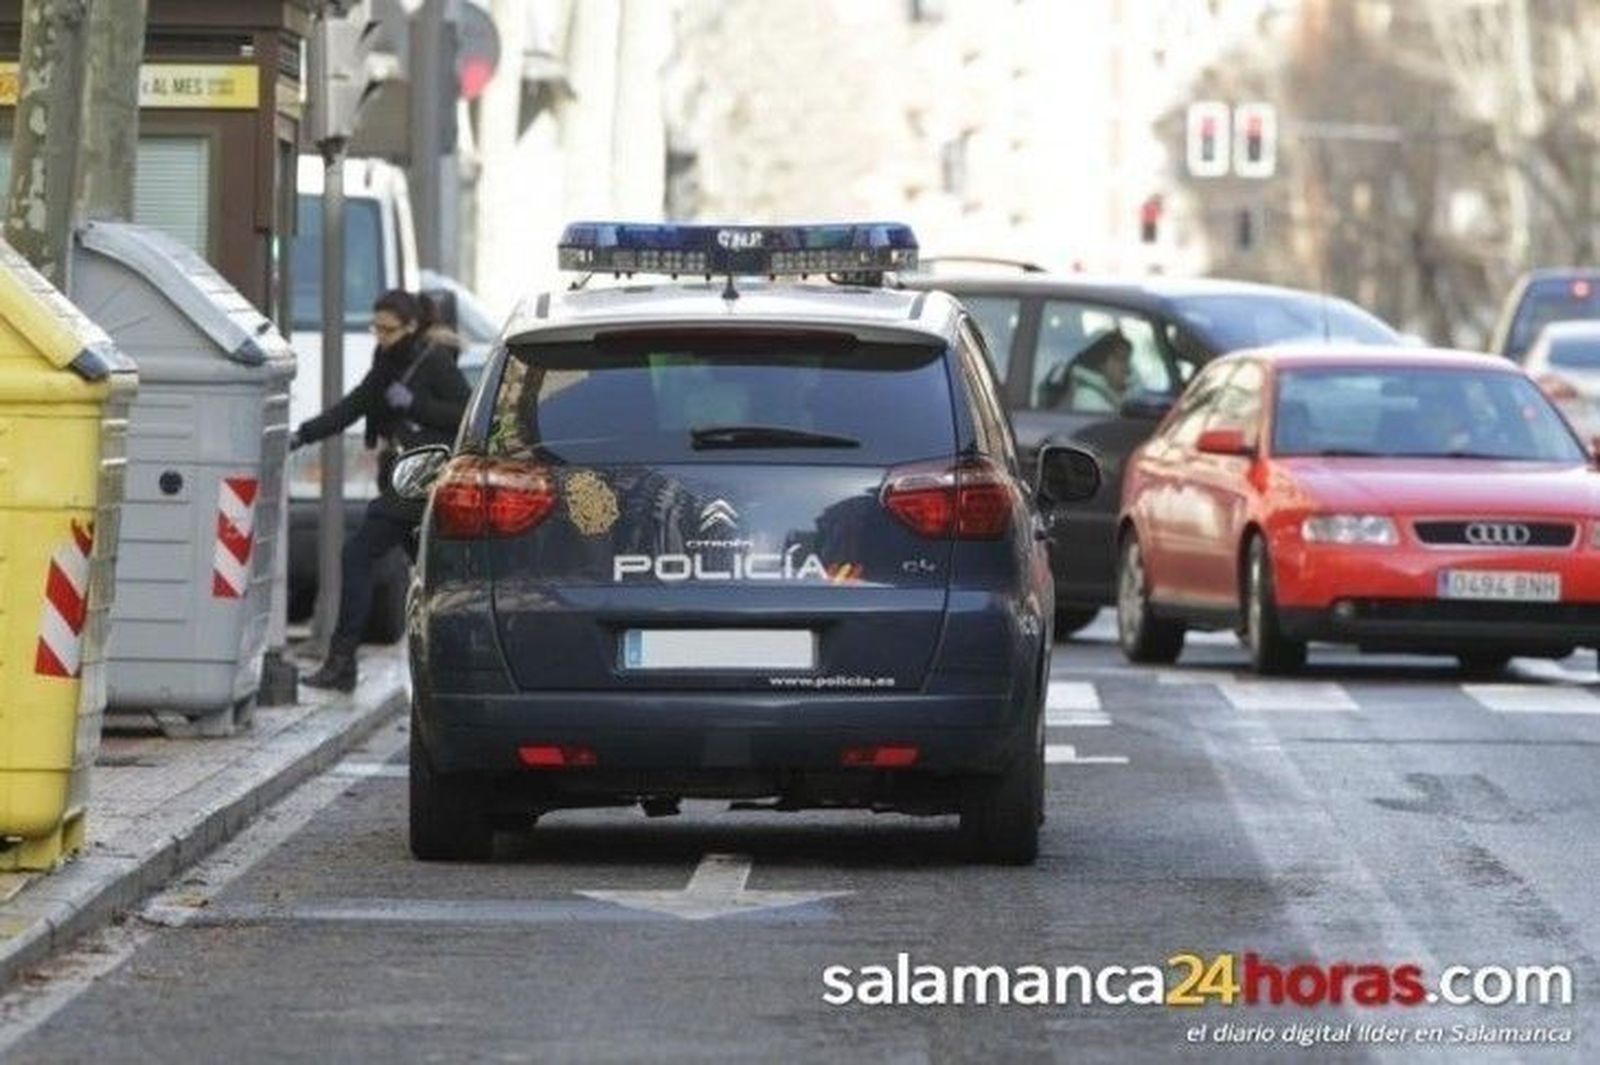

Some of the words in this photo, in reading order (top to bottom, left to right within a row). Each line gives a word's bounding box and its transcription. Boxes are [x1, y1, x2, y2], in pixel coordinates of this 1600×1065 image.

[173, 78, 203, 95] MES
[613, 544, 828, 582] POLICÍA
[768, 675, 896, 689] www.policia.es
